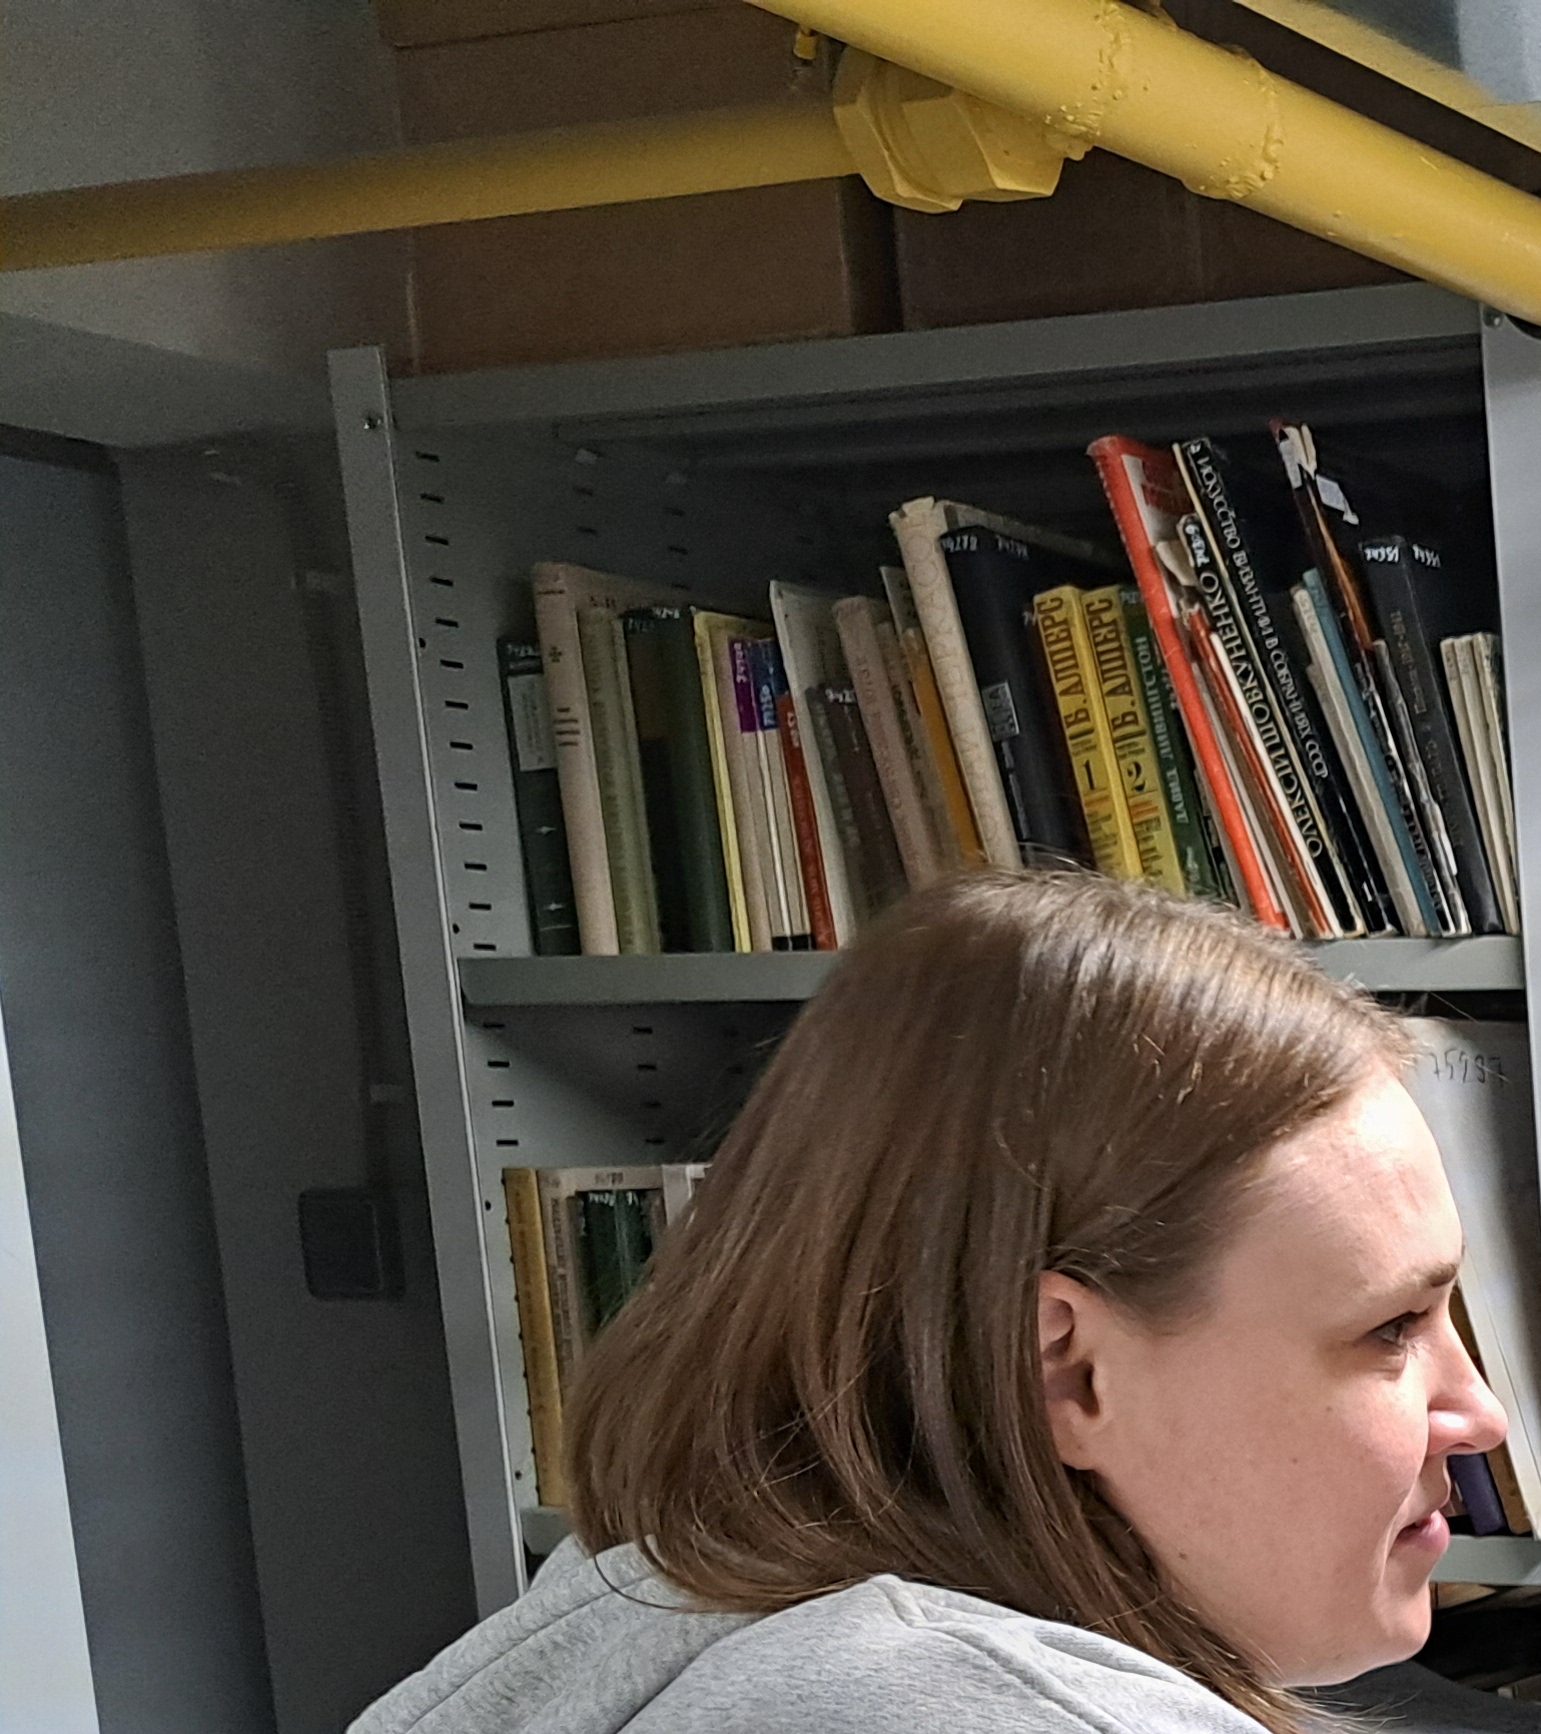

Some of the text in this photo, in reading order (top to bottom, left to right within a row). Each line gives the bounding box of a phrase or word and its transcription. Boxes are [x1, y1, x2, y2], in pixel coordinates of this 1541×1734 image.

[1196, 454, 1244, 549] ИСКУССТВО
[1232, 549, 1276, 635] ВИЗАНТИИ
[1269, 647, 1315, 739] СОБРАНИЯХ
[1302, 737, 1330, 779] СССР
[1196, 569, 1282, 747] ШОВКУНЕНКО
[1082, 760, 1096, 790] 1
[1127, 761, 1146, 792] 2
